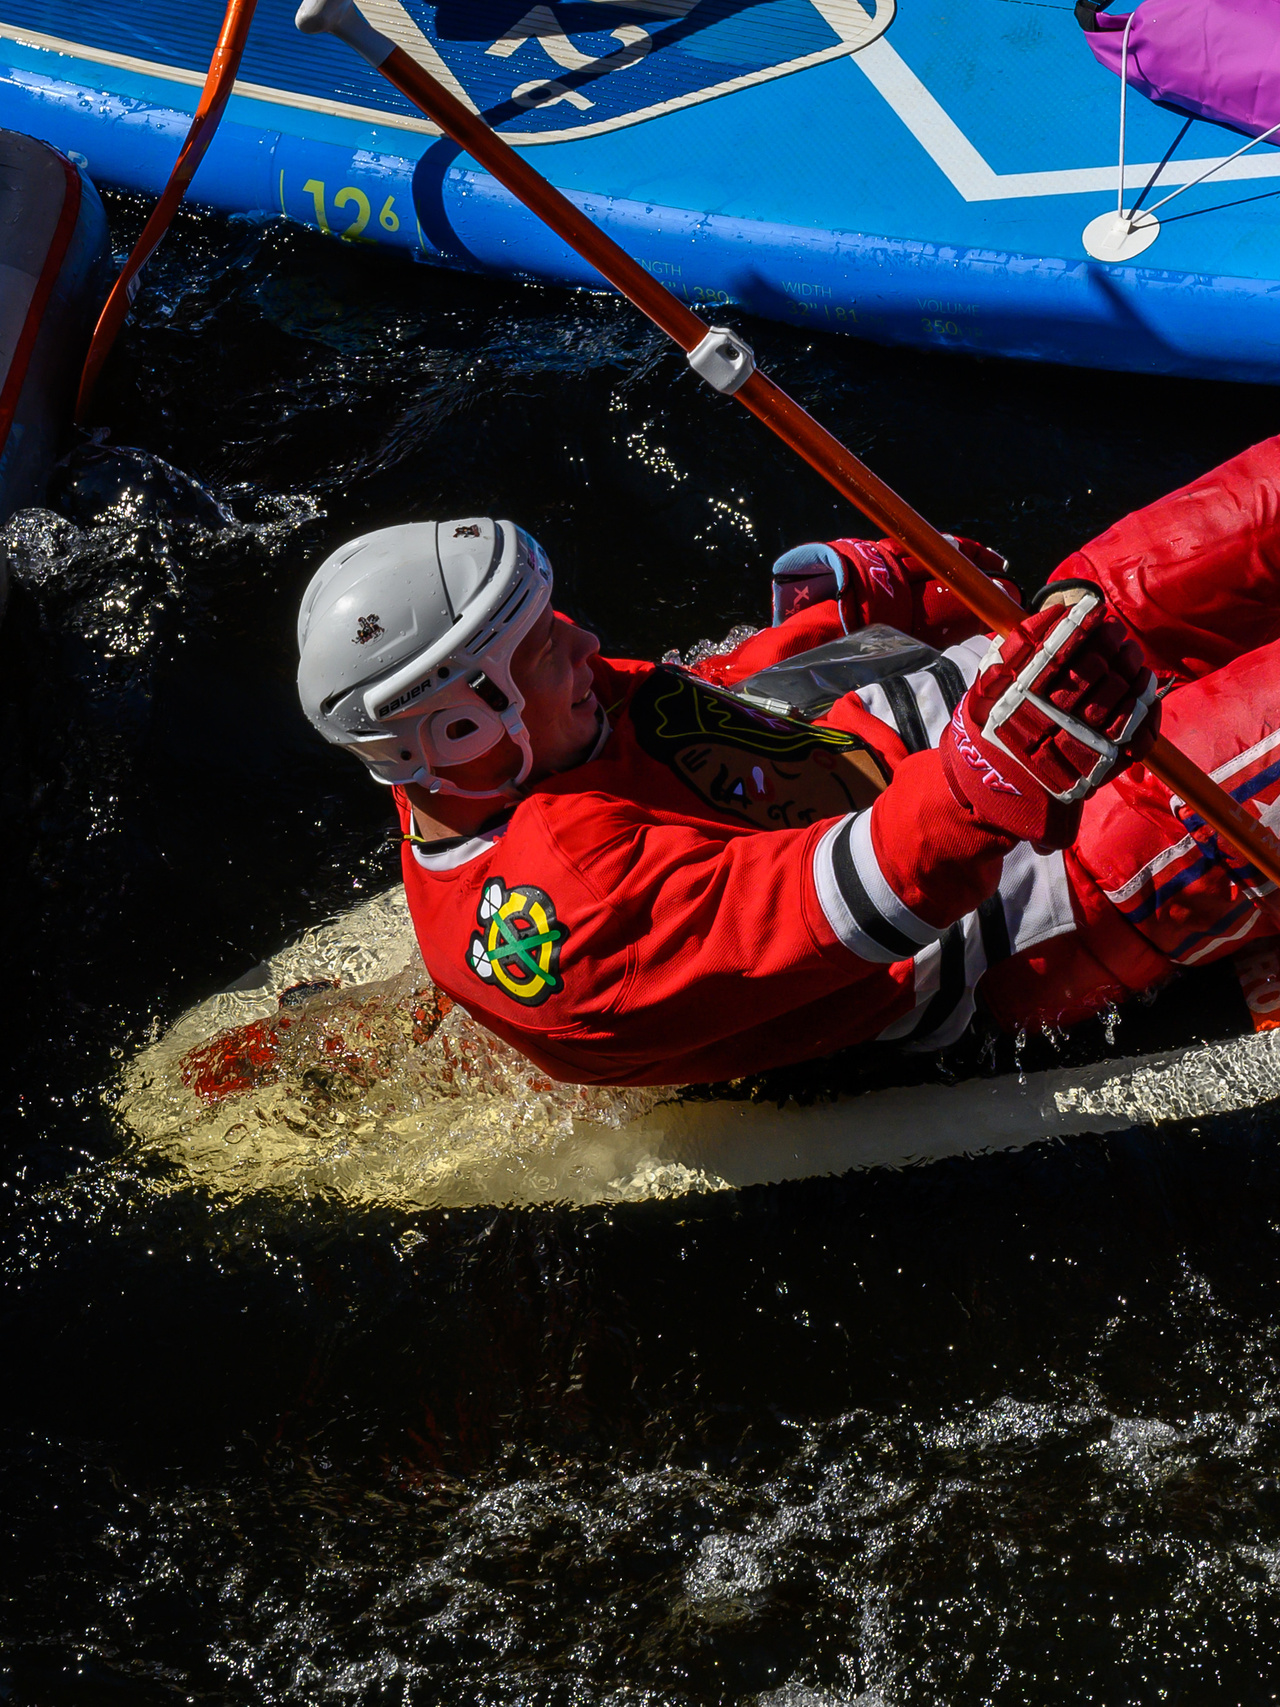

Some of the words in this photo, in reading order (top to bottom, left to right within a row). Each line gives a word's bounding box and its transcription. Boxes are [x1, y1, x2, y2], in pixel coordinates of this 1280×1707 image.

[633, 257, 682, 277] NGTH
[781, 281, 833, 298] WIDTH
[379, 679, 432, 717] BAUER
